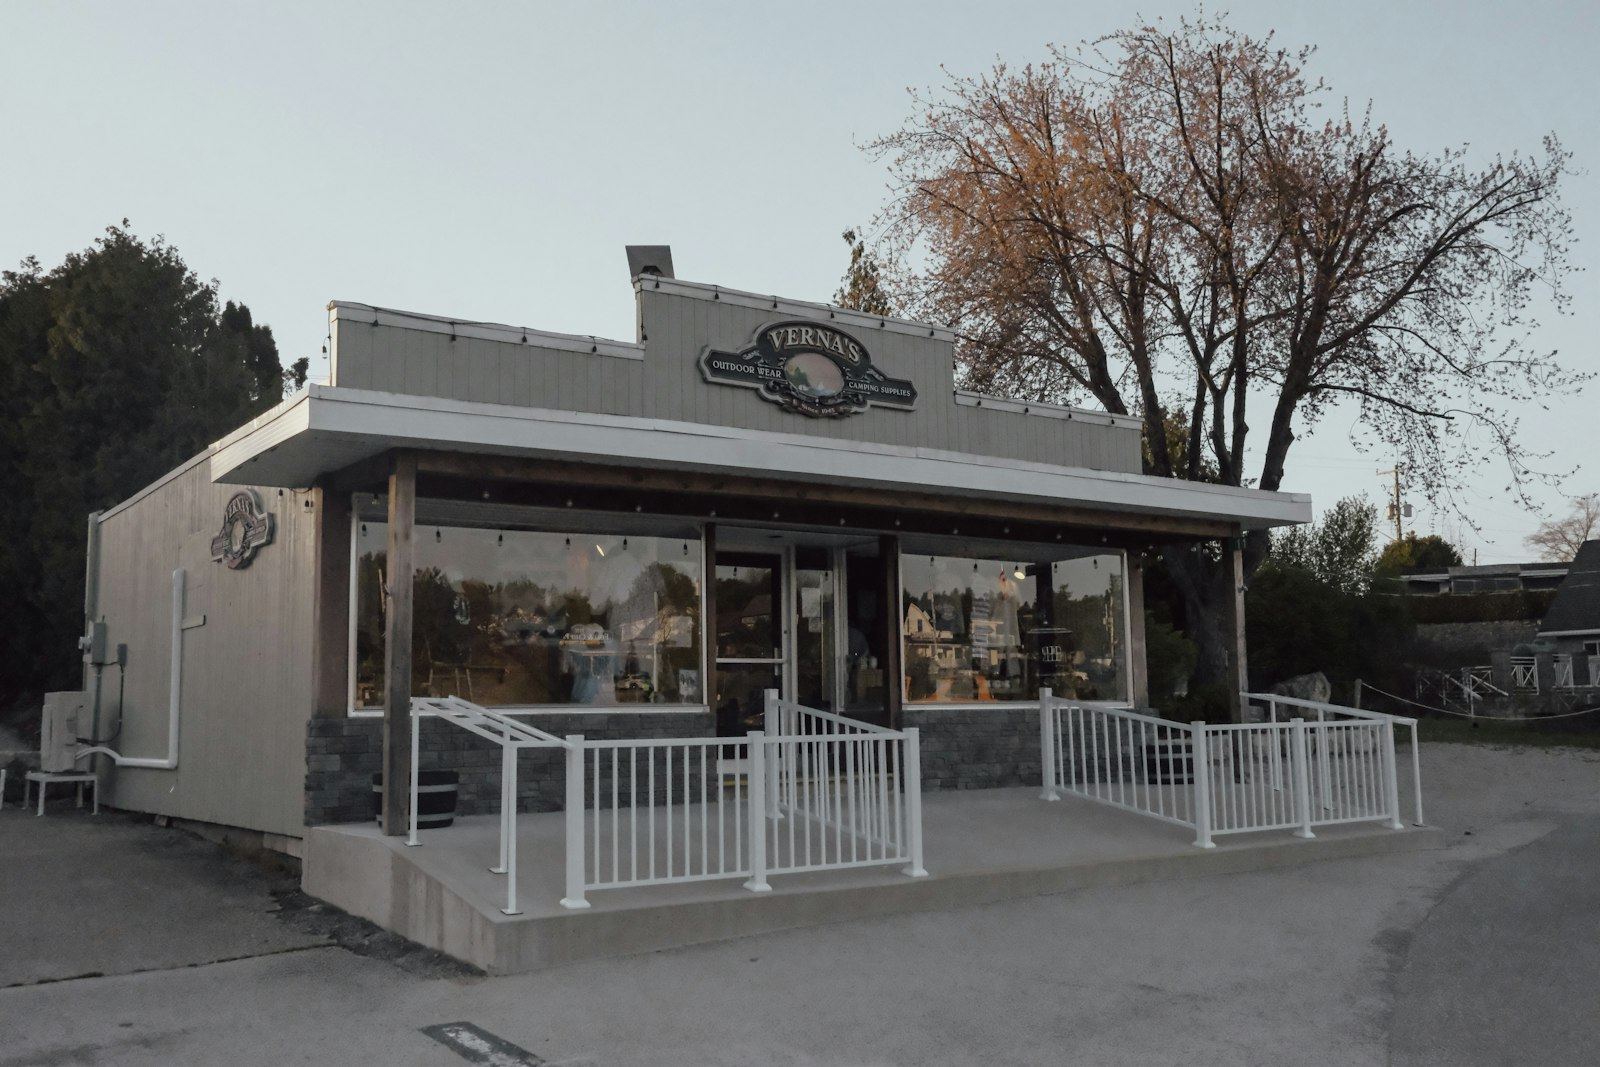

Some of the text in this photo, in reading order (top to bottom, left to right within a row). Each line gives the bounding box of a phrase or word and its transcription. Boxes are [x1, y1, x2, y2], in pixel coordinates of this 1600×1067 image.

[769, 327, 859, 362] VERNA'S
[712, 360, 782, 379] OUTDOOR WEAR
[848, 381, 911, 398] CAMPING SUPPLIES
